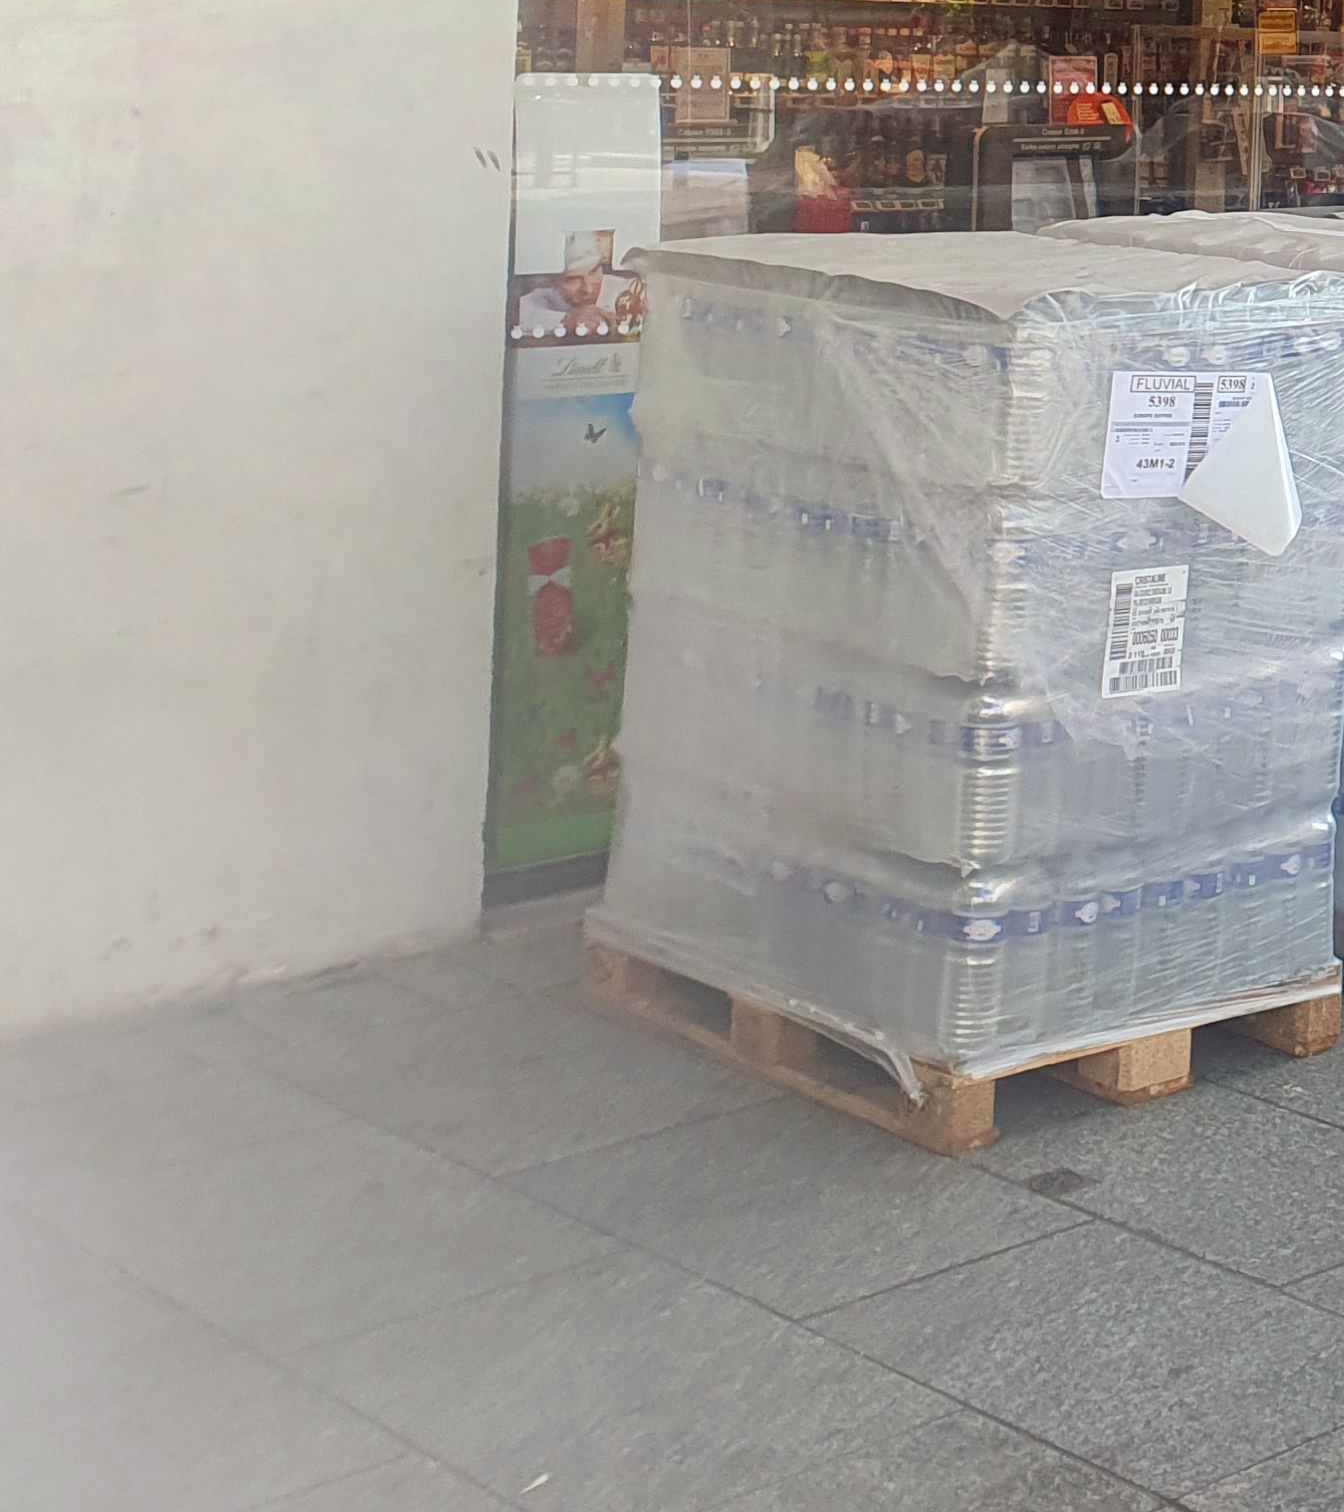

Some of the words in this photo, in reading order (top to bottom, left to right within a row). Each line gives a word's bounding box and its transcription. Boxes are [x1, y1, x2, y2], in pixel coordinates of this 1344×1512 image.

[1136, 378, 1190, 390] FLUVIAL
[1221, 379, 1246, 389] 5398
[1148, 396, 1176, 407] 5398
[1136, 459, 1175, 469] 43M1-2
